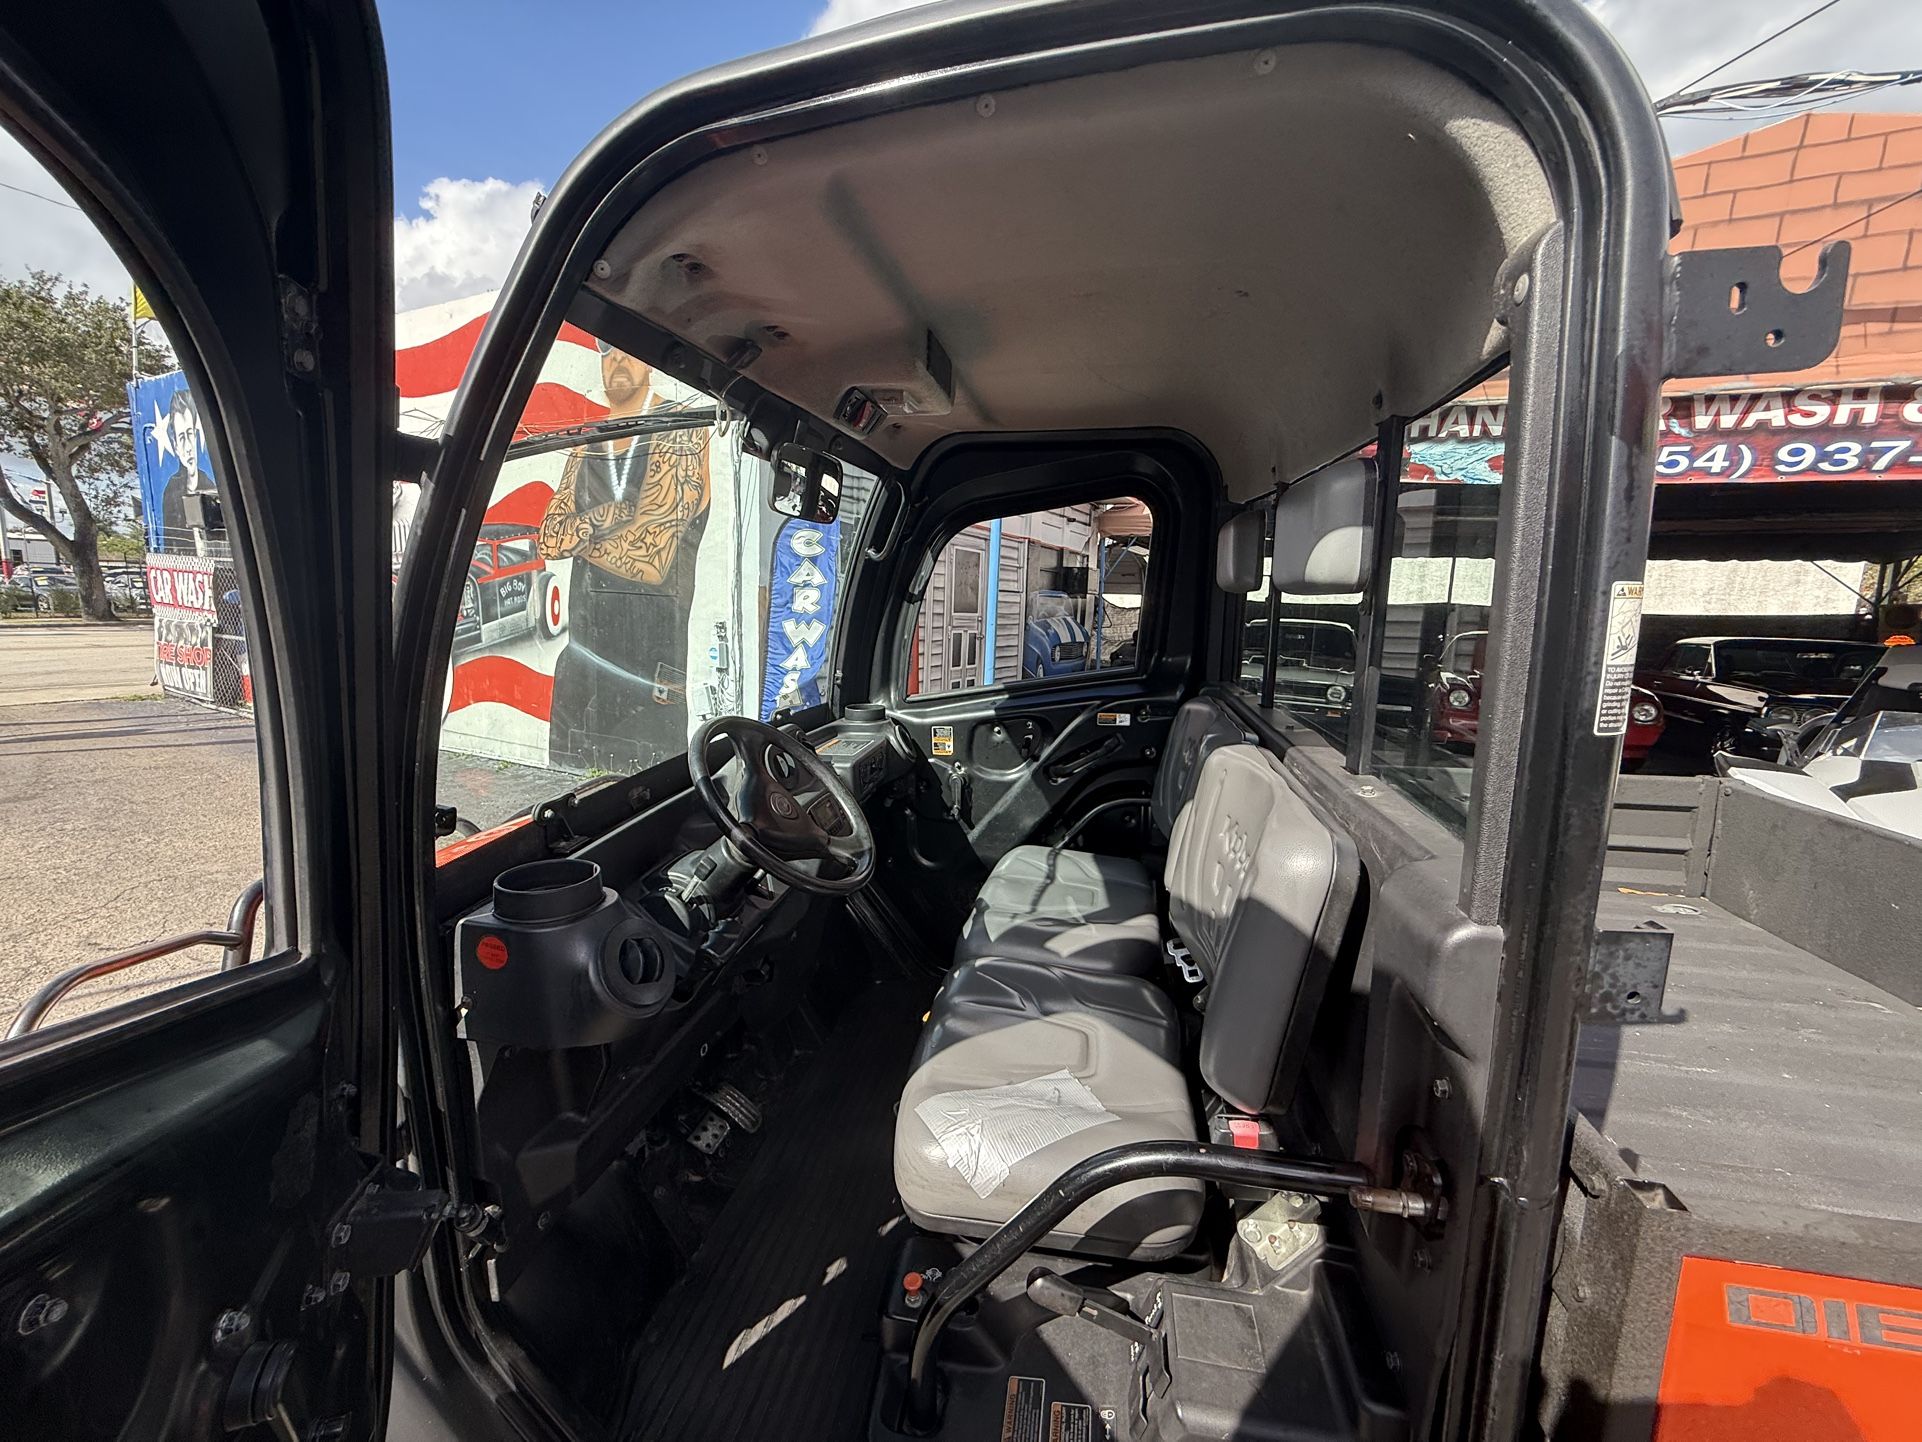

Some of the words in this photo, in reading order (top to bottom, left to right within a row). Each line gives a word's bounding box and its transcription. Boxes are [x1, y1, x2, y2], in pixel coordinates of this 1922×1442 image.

[1410, 404, 1507, 438] HAN
[1694, 387, 1884, 428] WASH
[649, 460, 662, 478] 58
[1655, 444, 1753, 479] 54)
[589, 543, 645, 580] Brooklyn
[150, 567, 173, 606] CAR
[173, 571, 215, 612] WASH
[500, 581, 512, 598] BIG
[512, 579, 526, 593] BOY
[176, 643, 212, 668] SHOP
[160, 663, 183, 689] NOW
[181, 666, 207, 694] OPEN
[1005, 1393, 1017, 1434] WARNING
[1051, 1409, 1061, 1442] ARNING
